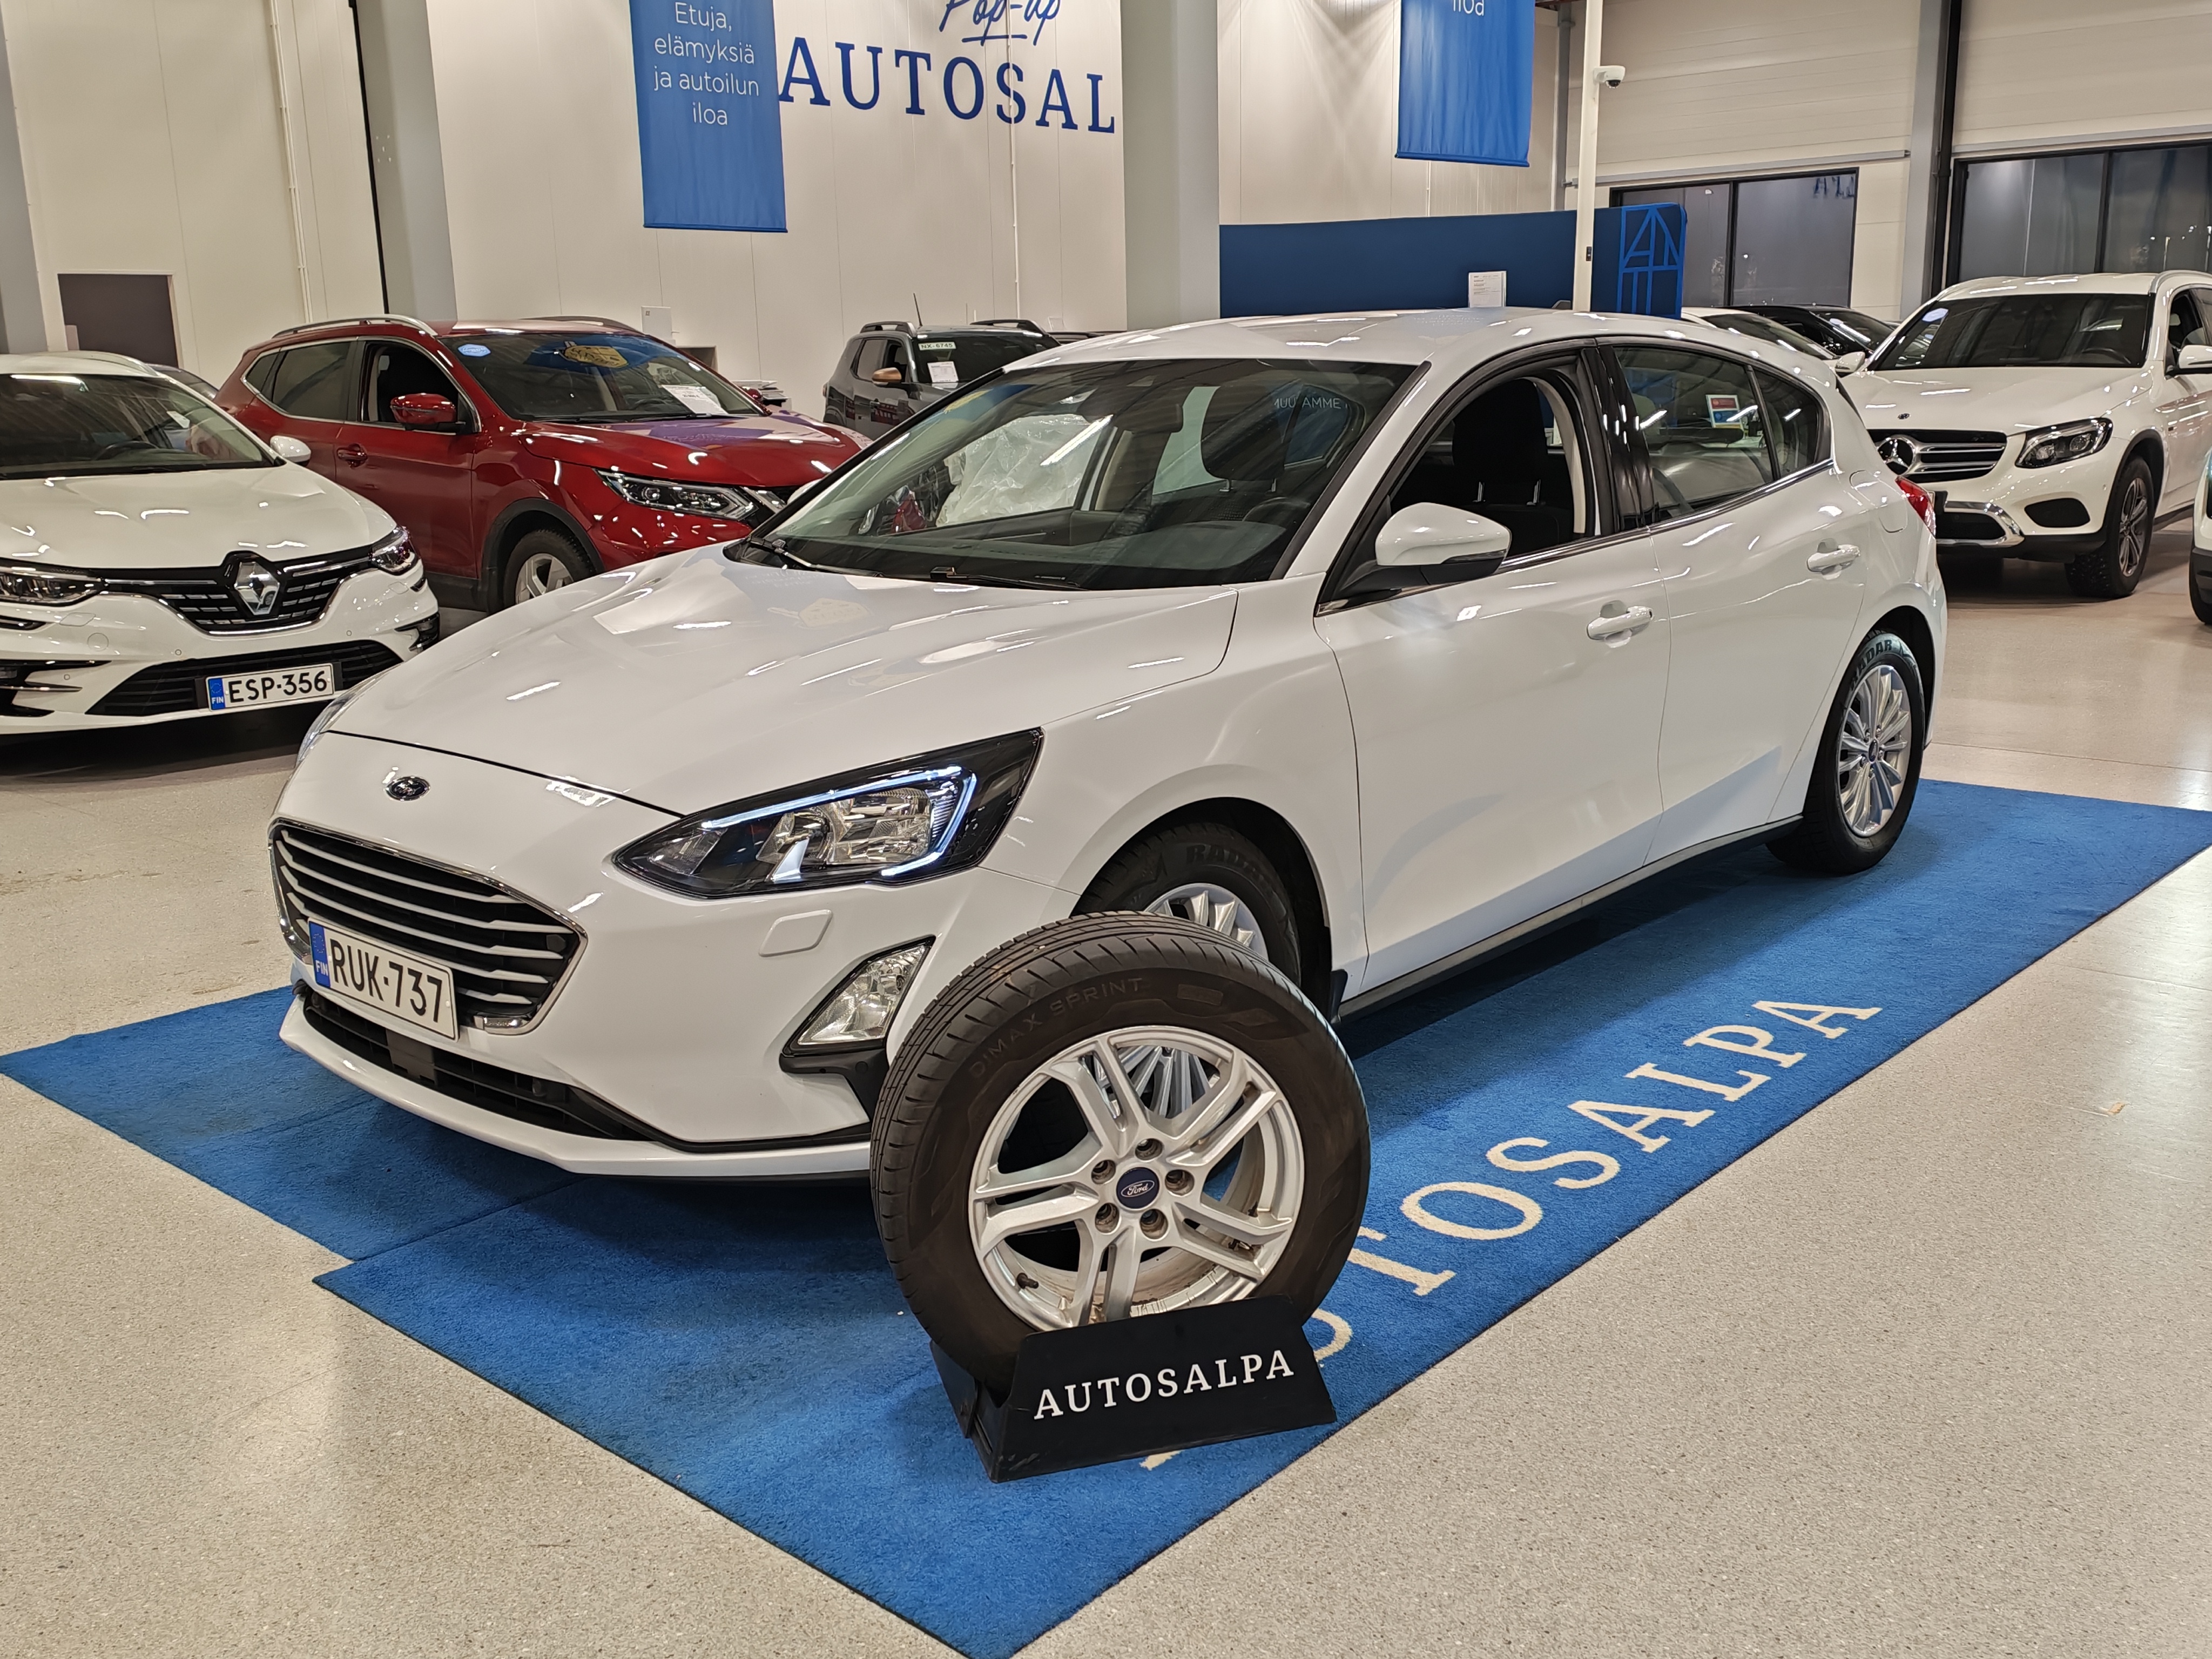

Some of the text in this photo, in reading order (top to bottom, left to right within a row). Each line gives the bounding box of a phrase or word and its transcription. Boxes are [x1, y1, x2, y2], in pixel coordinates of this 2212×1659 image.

[675, 2, 732, 32] Etuja,
[655, 33, 754, 64] elämyksiä
[654, 65, 759, 96] ja autoilun
[778, 36, 1115, 134] AUTOSAL
[692, 102, 727, 125] iloa
[1274, 397, 1341, 409] UUAMME
[211, 671, 327, 704] FIN ESP-356
[315, 938, 442, 1023] FIN RUK-737
[969, 977, 1143, 1078] DIMAX SPRINT
[1138, 1000, 1883, 1469] TOSALPA
[1034, 1350, 1294, 1420] AUTOSALPA
